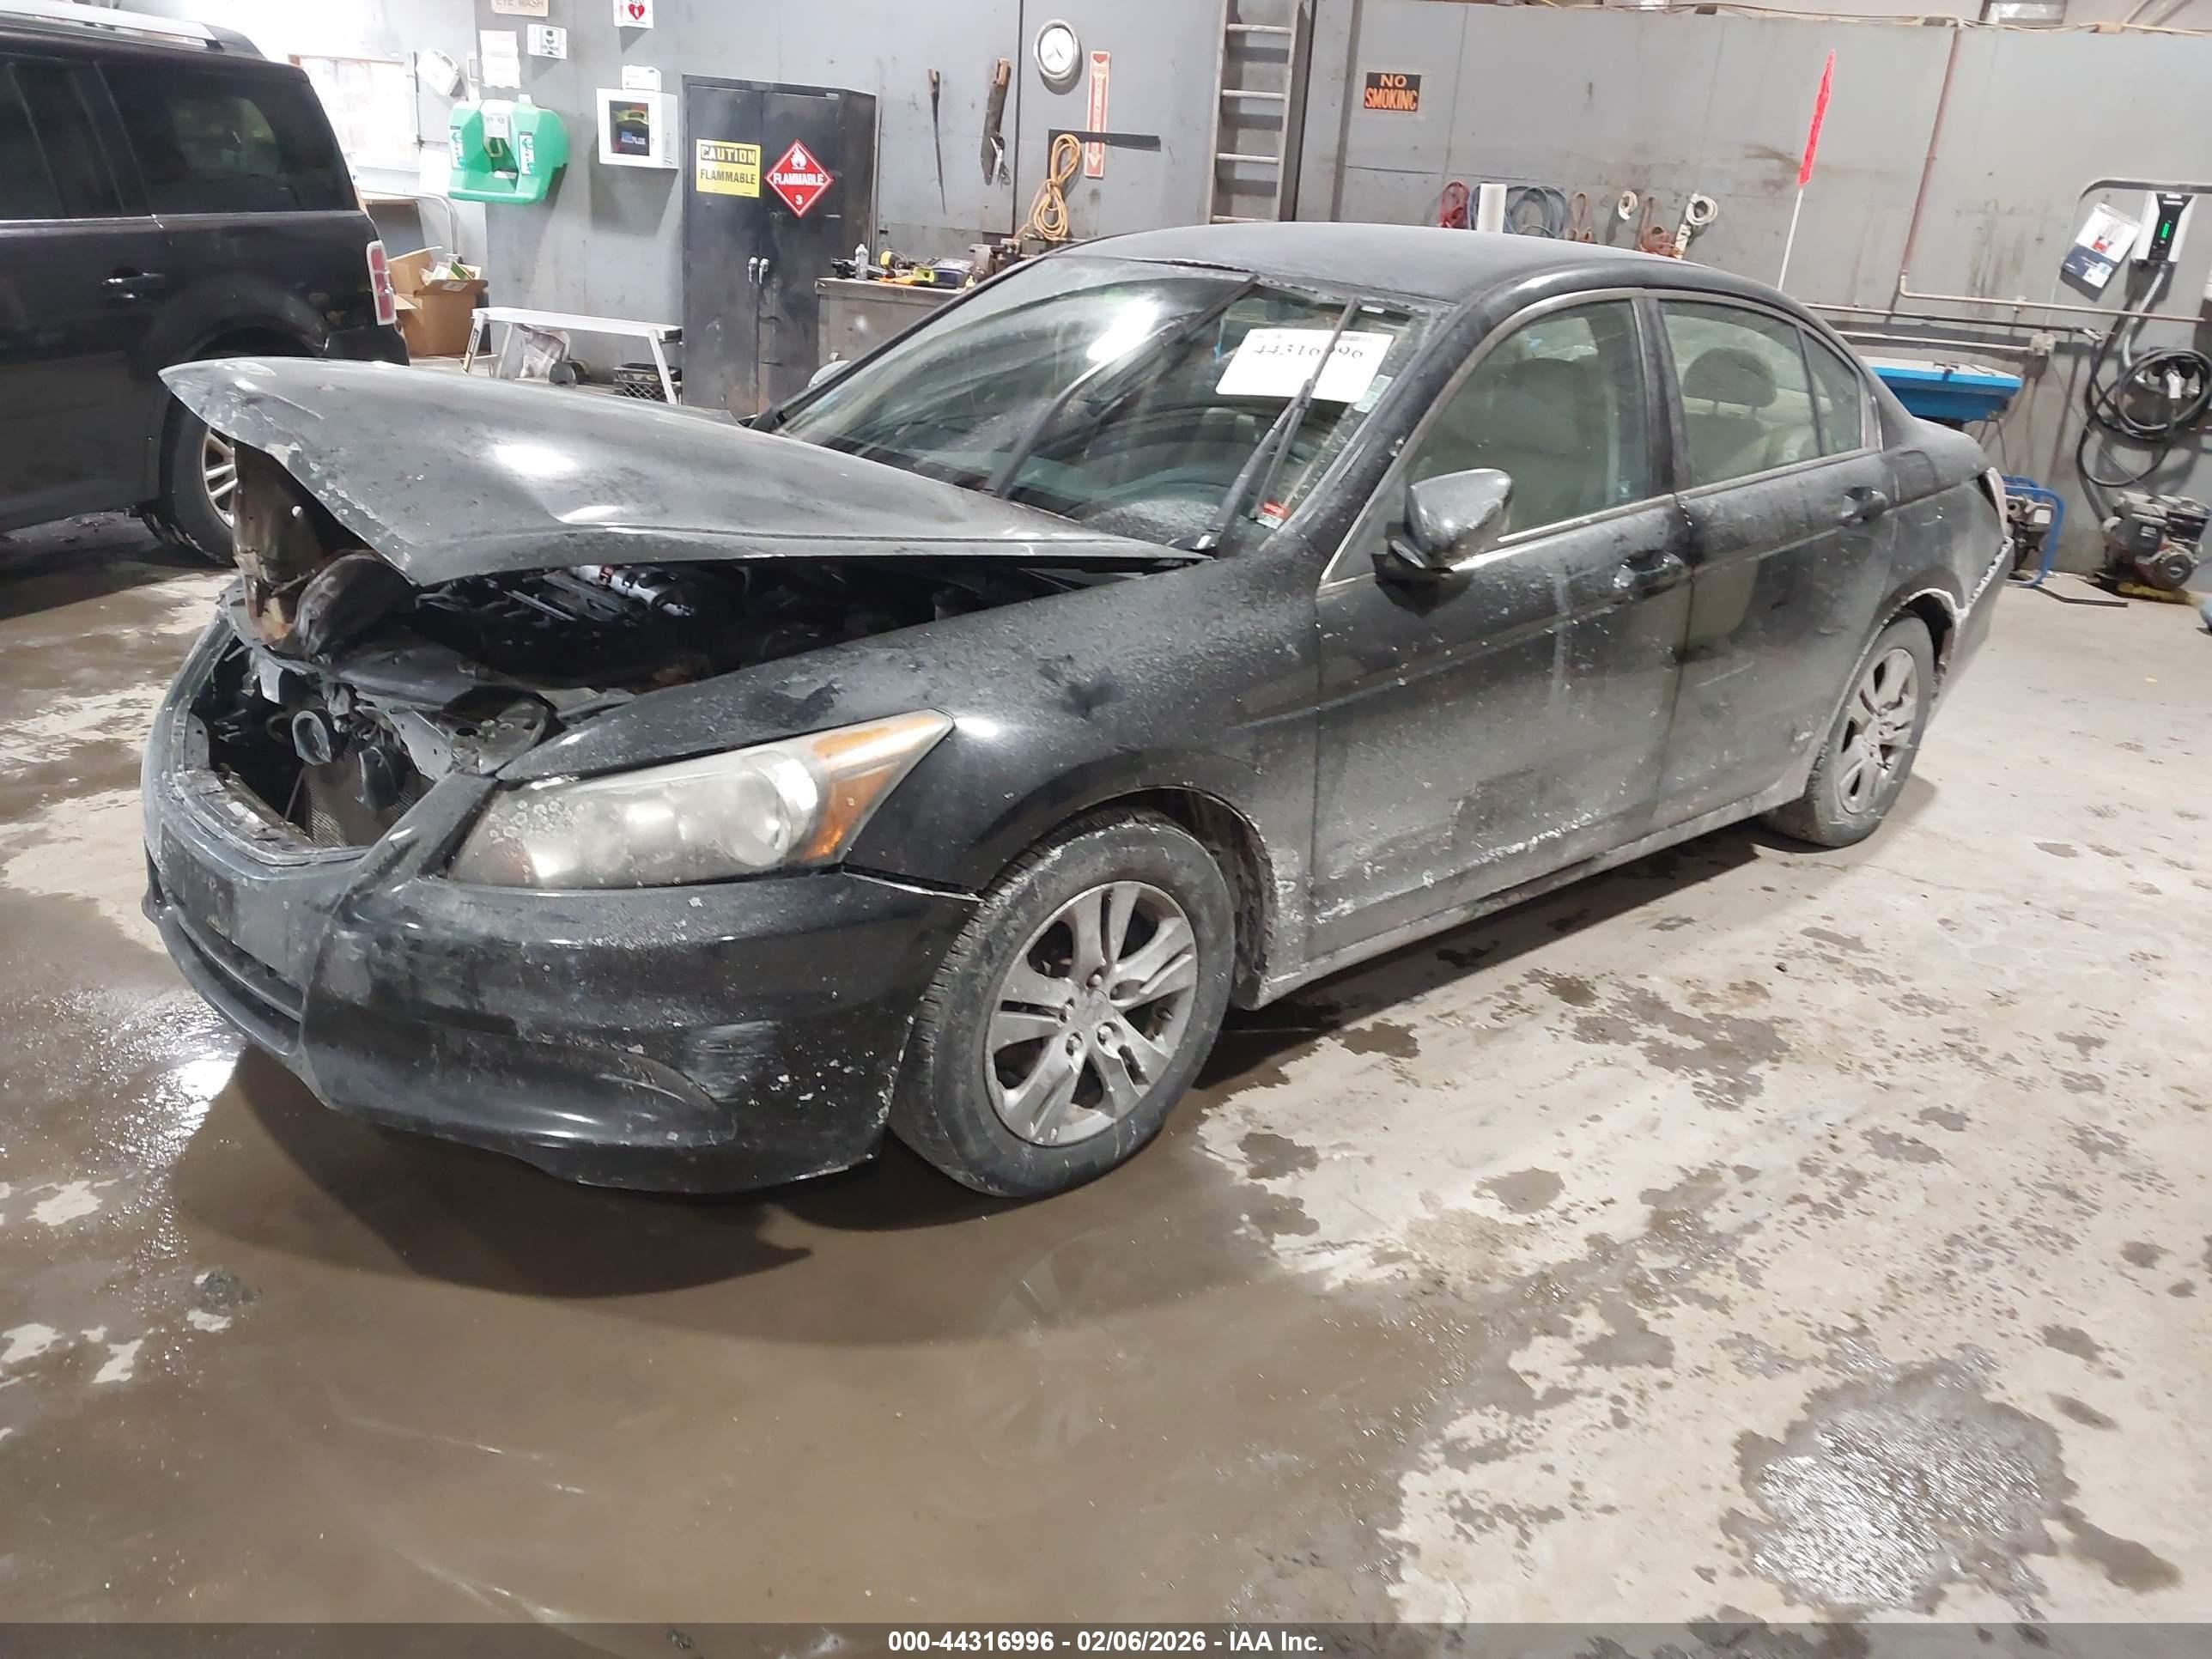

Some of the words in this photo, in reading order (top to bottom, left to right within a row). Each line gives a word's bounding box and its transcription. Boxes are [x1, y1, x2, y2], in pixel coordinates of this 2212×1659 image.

[1380, 74, 1407, 88] NO
[1365, 88, 1418, 110] SMOKING
[701, 145, 757, 165] CAUTION
[700, 169, 757, 185] FLAMMABLE
[773, 172, 825, 186] FLAMMABLE
[795, 194, 804, 205] 3
